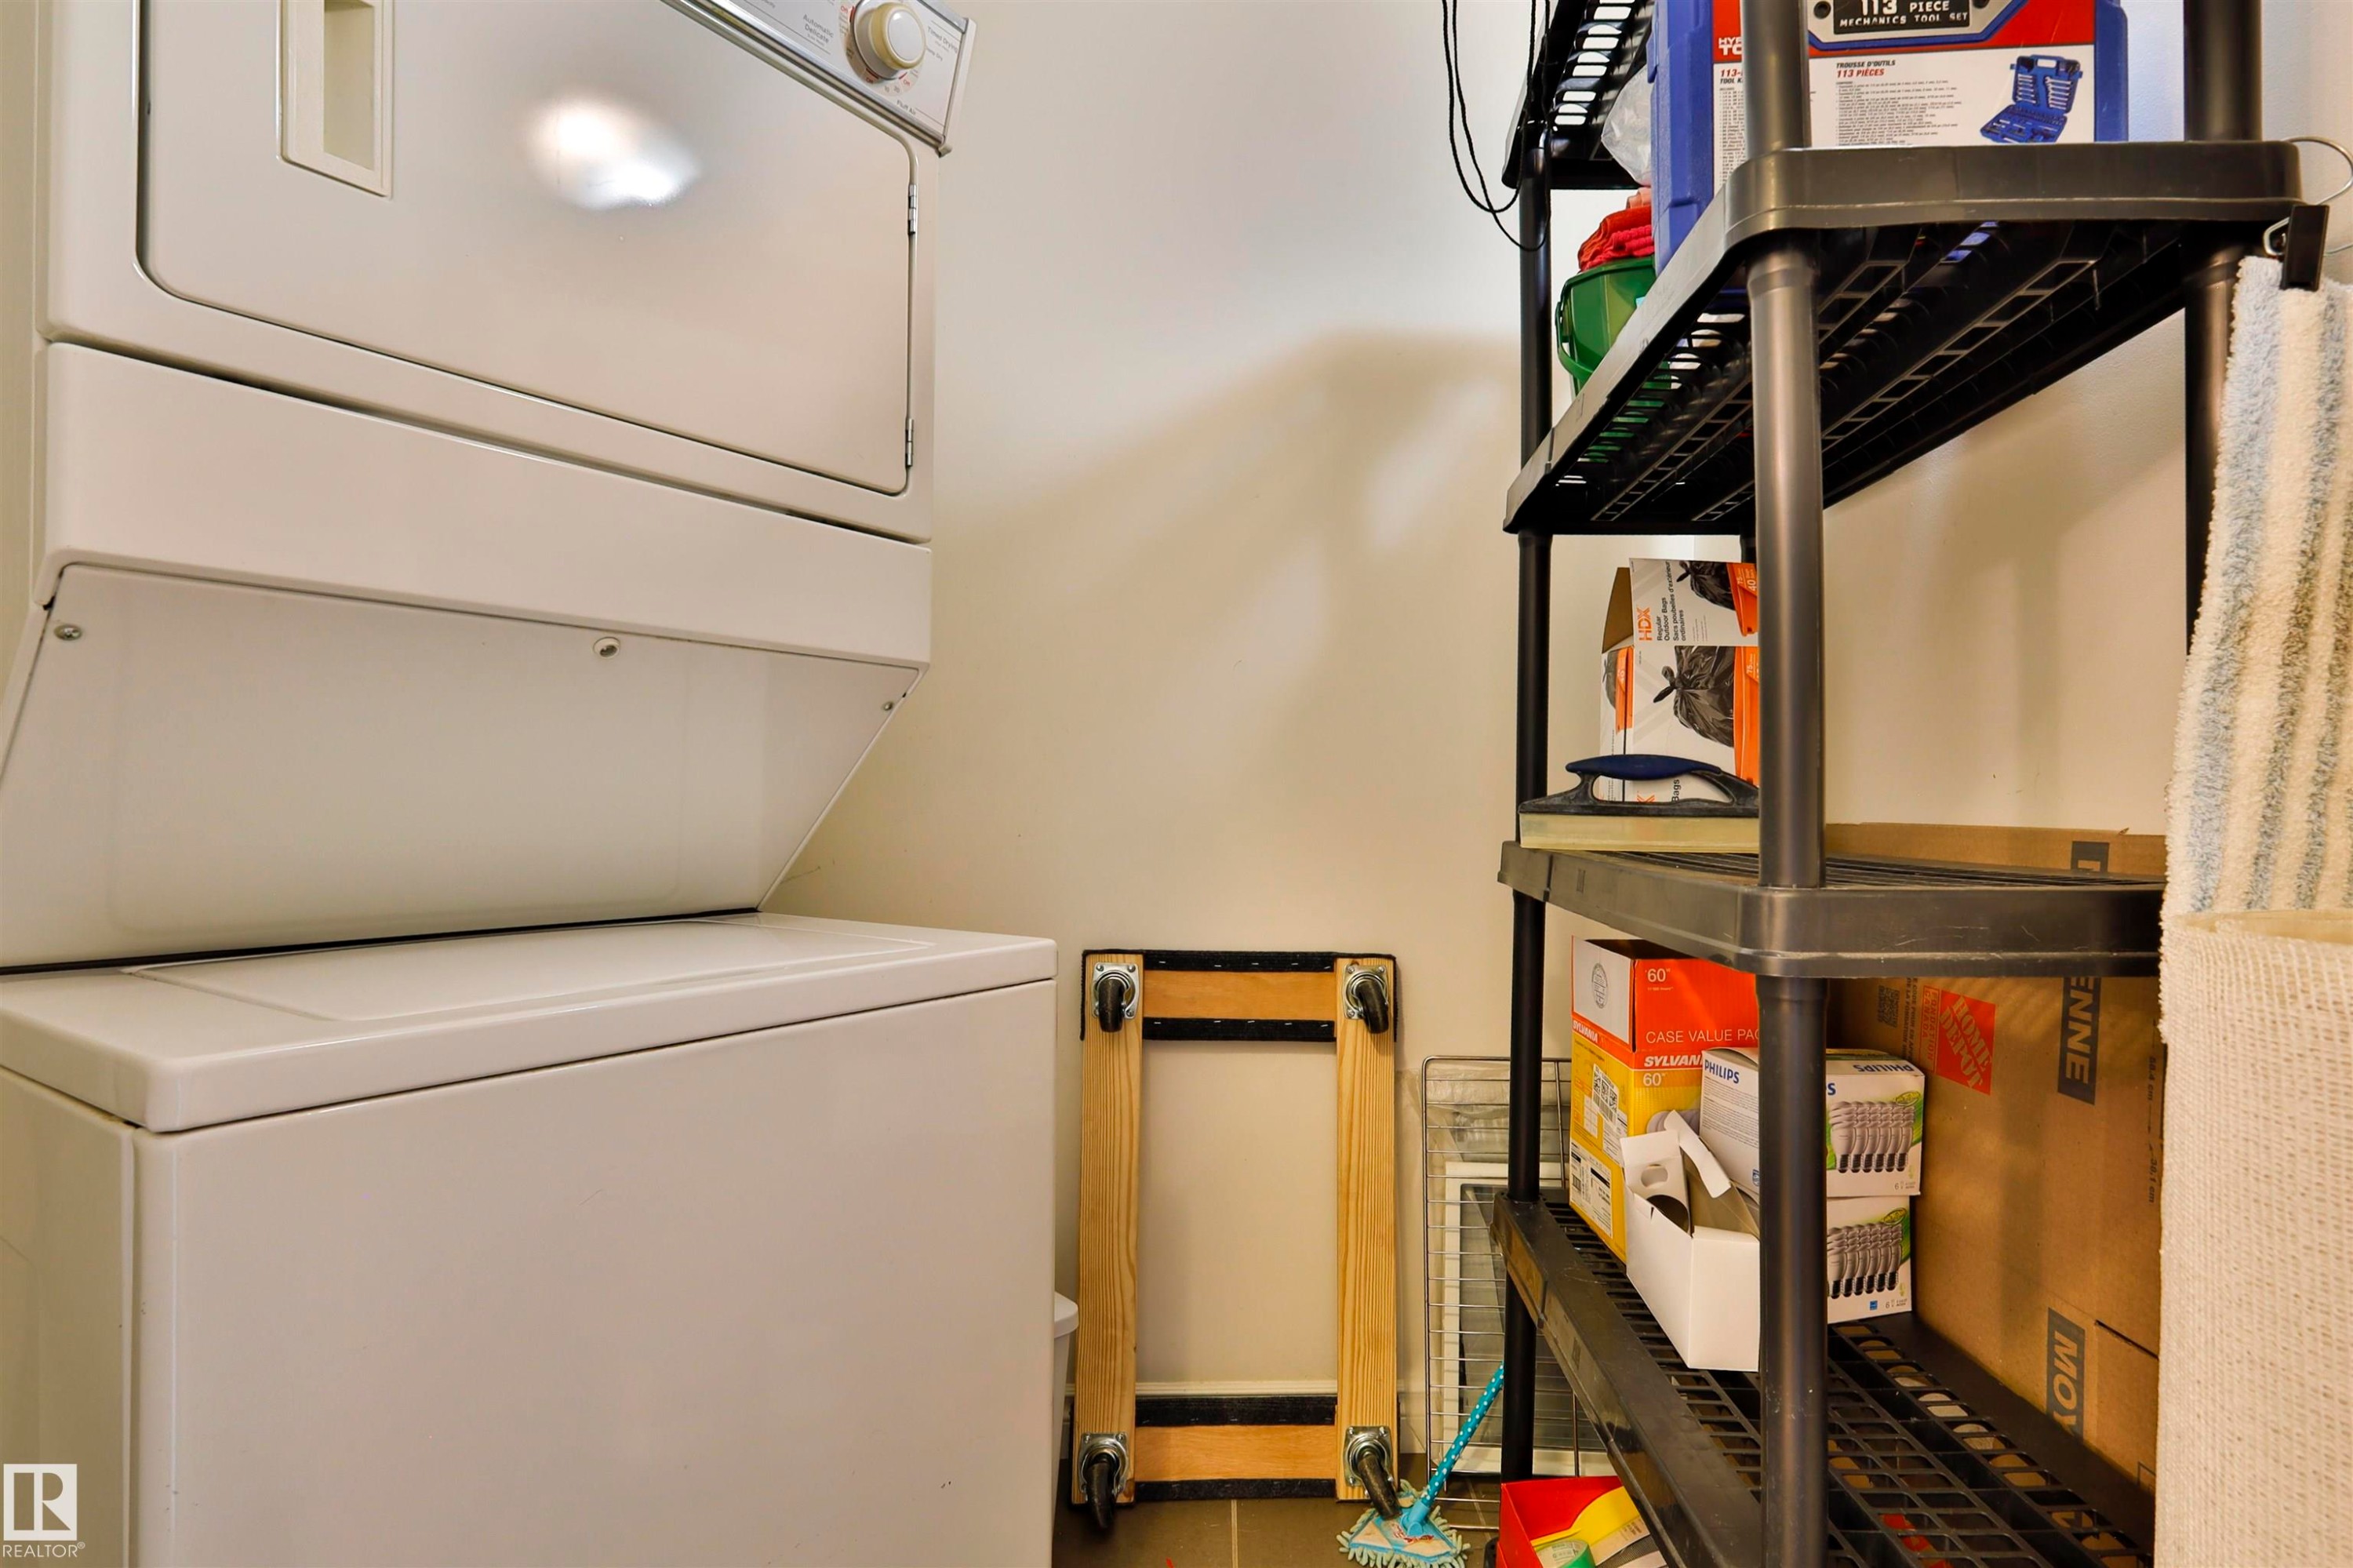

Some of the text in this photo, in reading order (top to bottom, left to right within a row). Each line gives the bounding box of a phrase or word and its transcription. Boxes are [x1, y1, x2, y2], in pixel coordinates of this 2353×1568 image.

[1839, 12, 1968, 27] MECHANICS TOOL SET
[1862, 0, 1950, 16] 113 PIECE
[802, 13, 834, 38] Automatic
[805, 24, 830, 43] Delicate
[1837, 69, 1854, 78] 113
[1670, 594, 1678, 624] poubelles
[1636, 606, 1653, 642] HDX
[1671, 779, 1682, 803] Bags
[1922, 990, 1932, 1039] CANADA
[1928, 990, 1938, 1060] FONDATION
[1573, 1020, 1598, 1043] SYLVANIA
[1646, 1030, 1684, 1044] CASE
[1688, 1028, 1733, 1042] VALUE
[1952, 995, 1993, 1072] HOME
[1939, 1006, 1984, 1089] DEPOT
[1704, 1059, 1740, 1084] PHILIPS
[2148, 1185, 2155, 1203] cm
